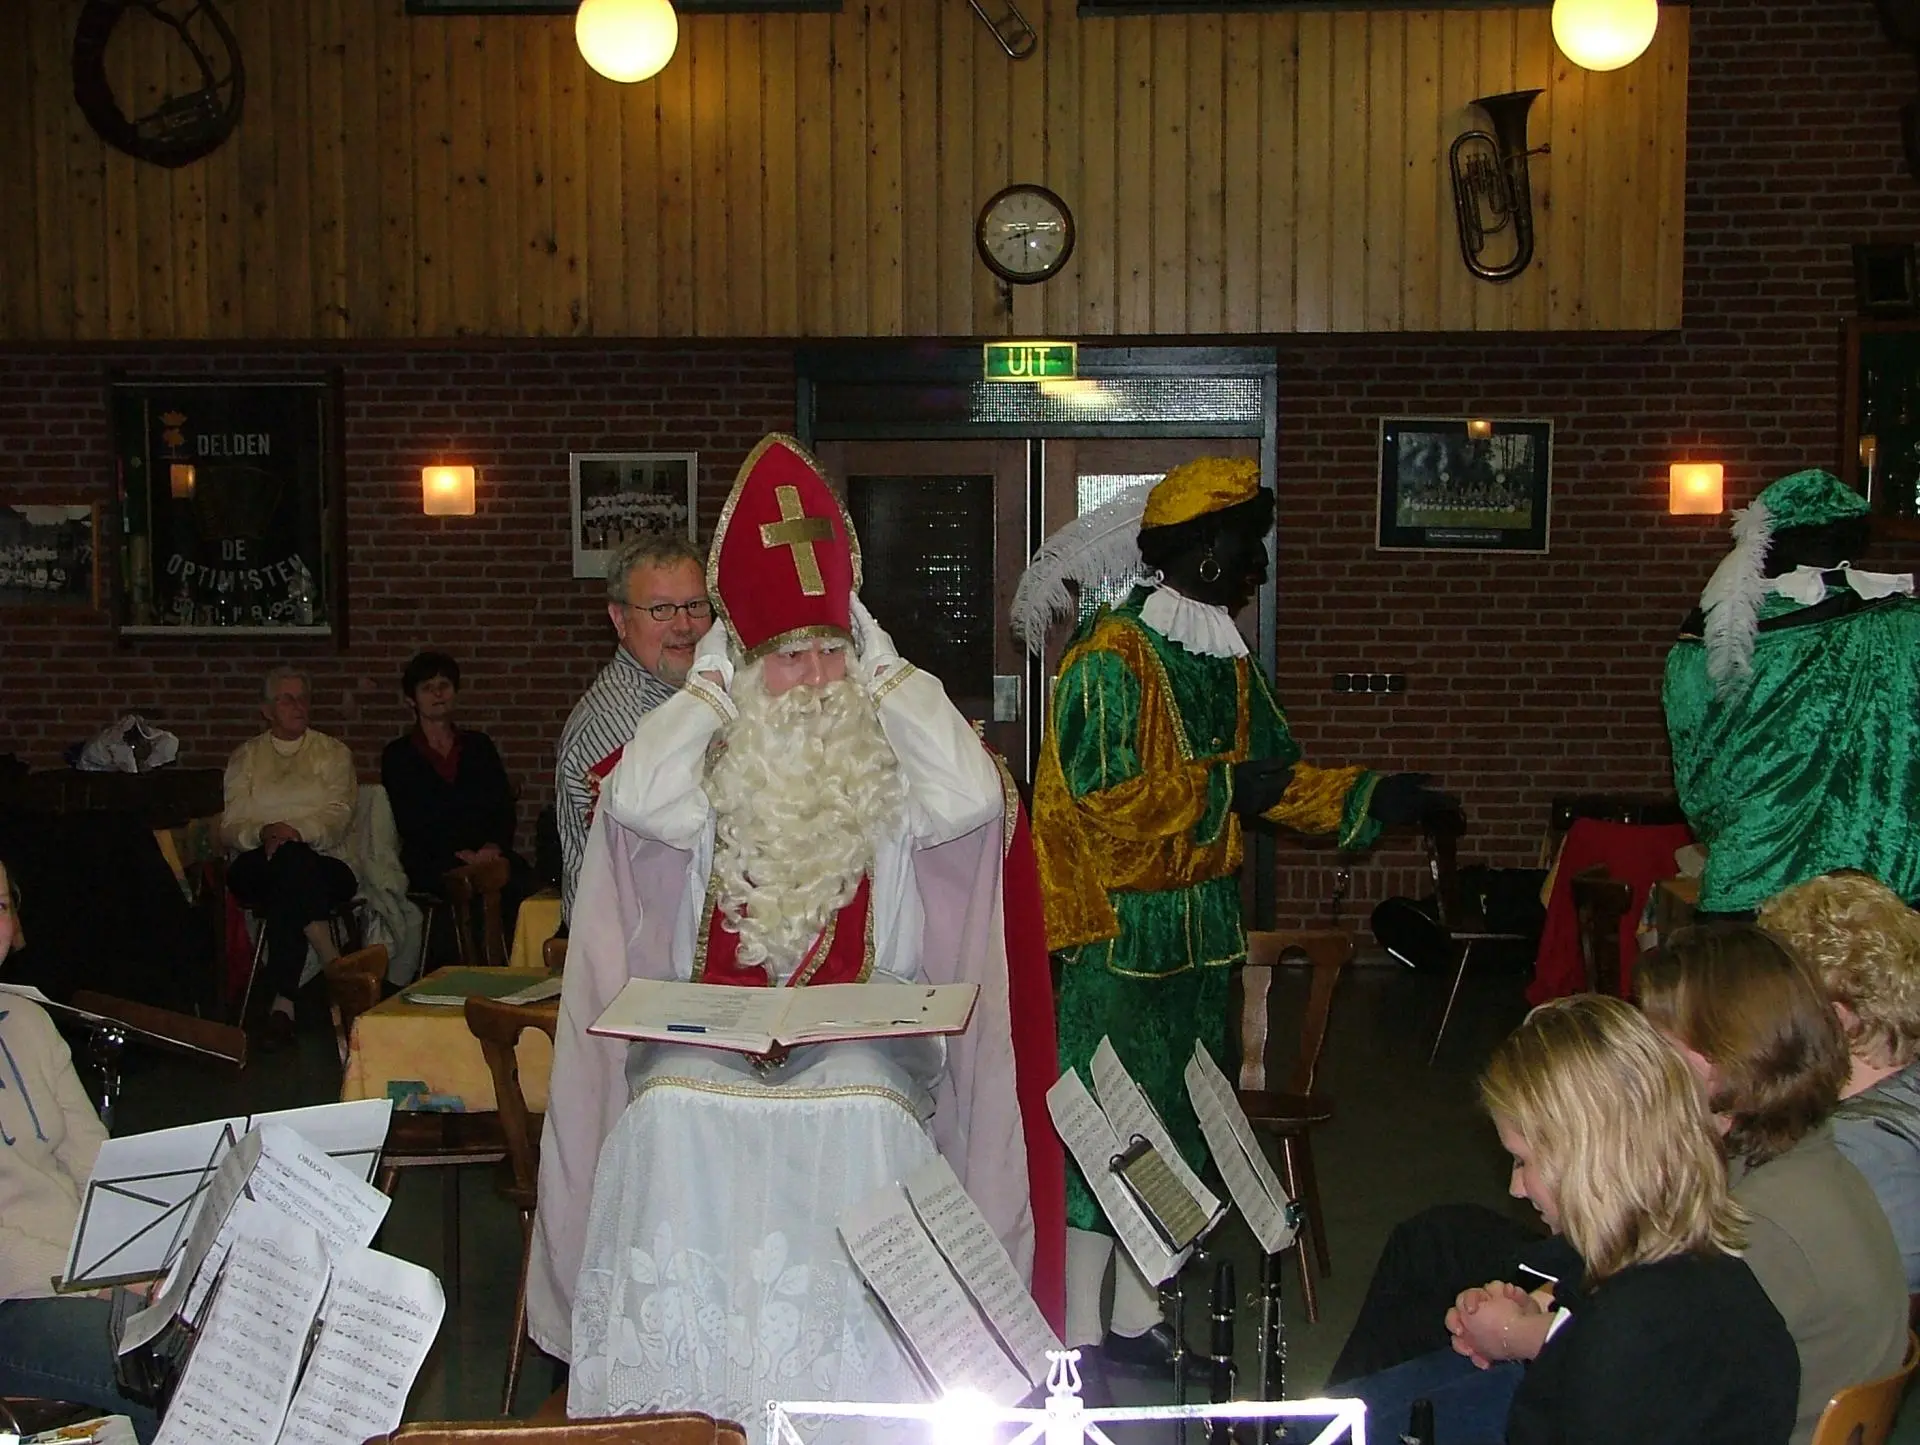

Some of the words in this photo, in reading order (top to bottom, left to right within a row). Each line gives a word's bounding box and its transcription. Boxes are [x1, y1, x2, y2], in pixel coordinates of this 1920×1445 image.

[1008, 347, 1050, 376] UIT
[197, 433, 270, 456] DELDEN
[222, 539, 247, 561] DE
